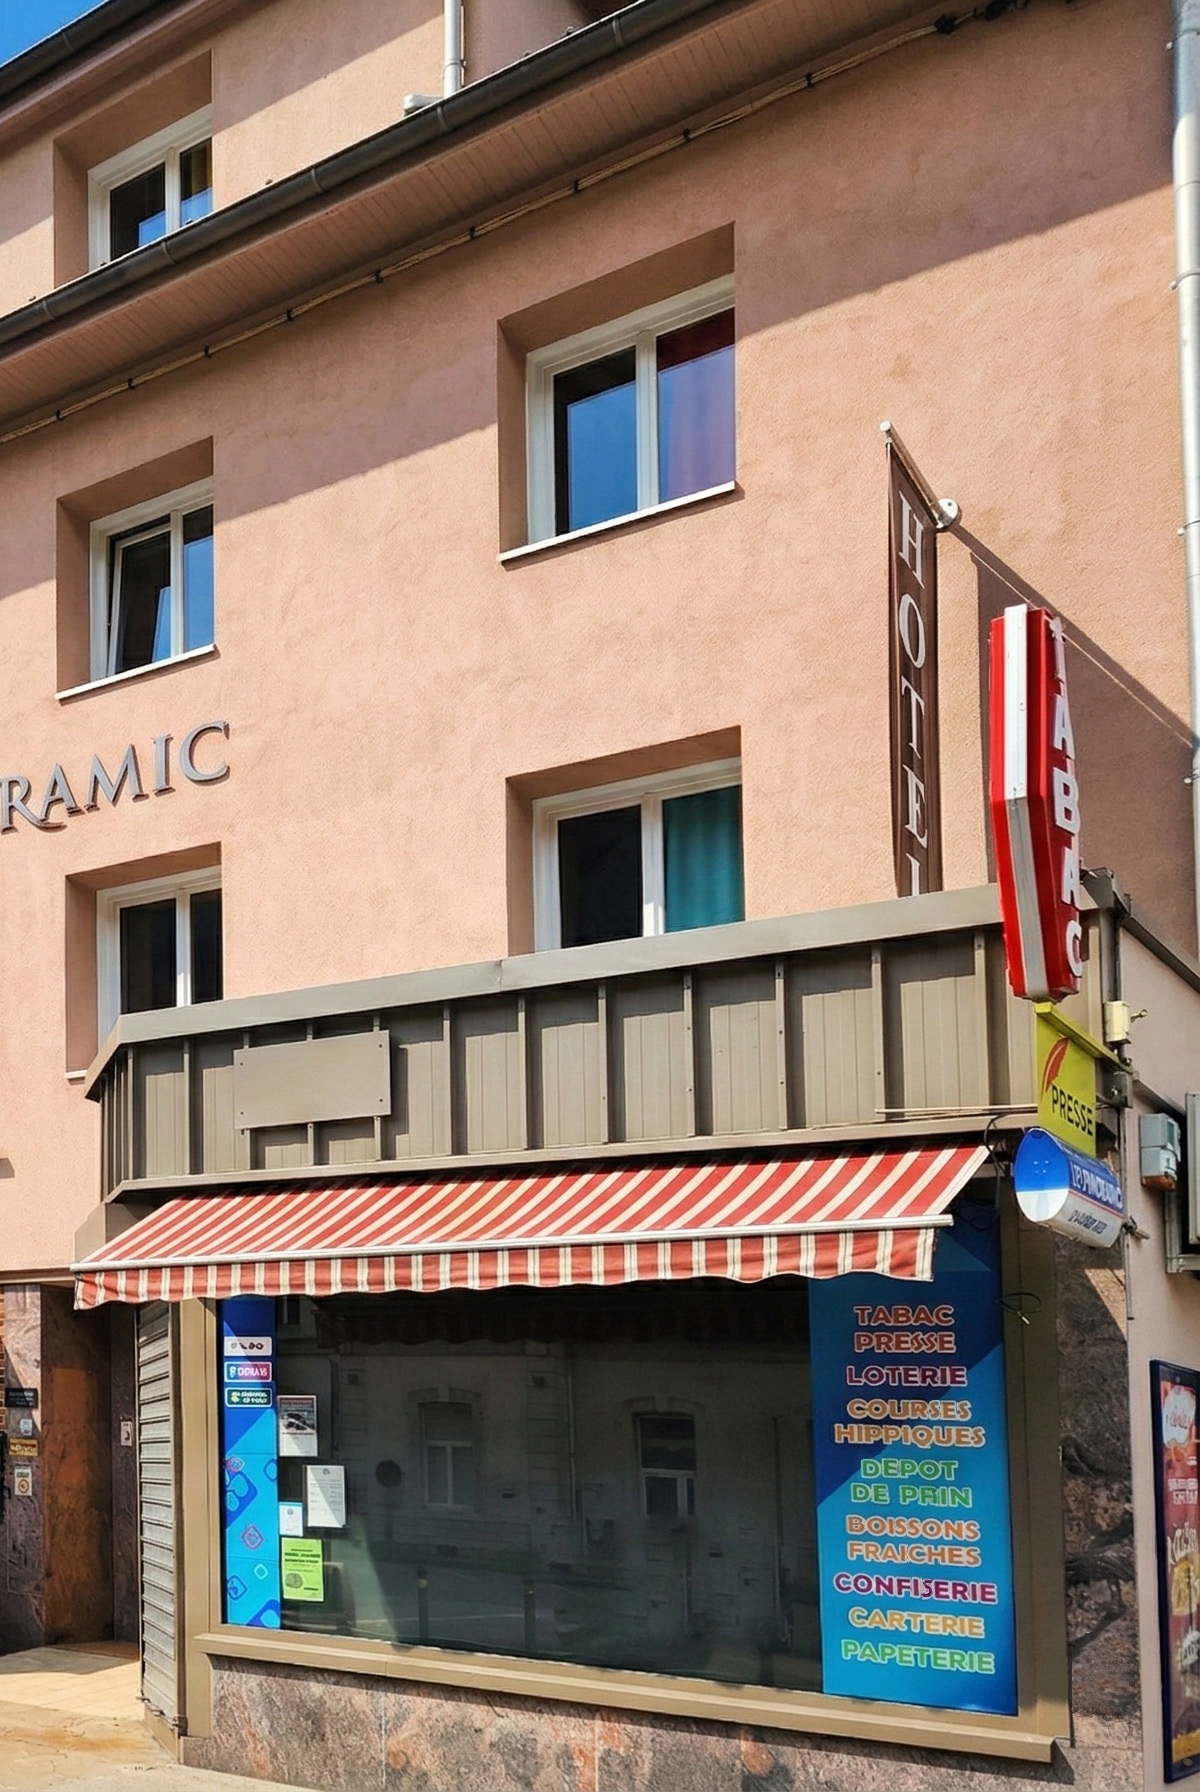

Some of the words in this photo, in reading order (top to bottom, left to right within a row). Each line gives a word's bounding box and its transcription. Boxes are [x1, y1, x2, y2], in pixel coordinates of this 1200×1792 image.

[1050, 616, 1083, 979] TABAC
[1050, 1084, 1095, 1138] PRESSE
[854, 1305, 955, 1326] TABAC
[854, 1332, 956, 1353] PRESSE
[846, 1365, 968, 1386] LOTERIE
[847, 1398, 972, 1421] COURSES
[834, 1424, 986, 1448] HIPPIQUES
[861, 1458, 958, 1481] DEPOT
[851, 1483, 889, 1504] DE
[846, 1515, 980, 1541] BOISSONS
[847, 1541, 981, 1567] FRAICHES
[833, 1572, 998, 1604] CONFISERIE
[848, 1606, 985, 1638] CARTERIE
[841, 1639, 995, 1674] PAPETERIE
